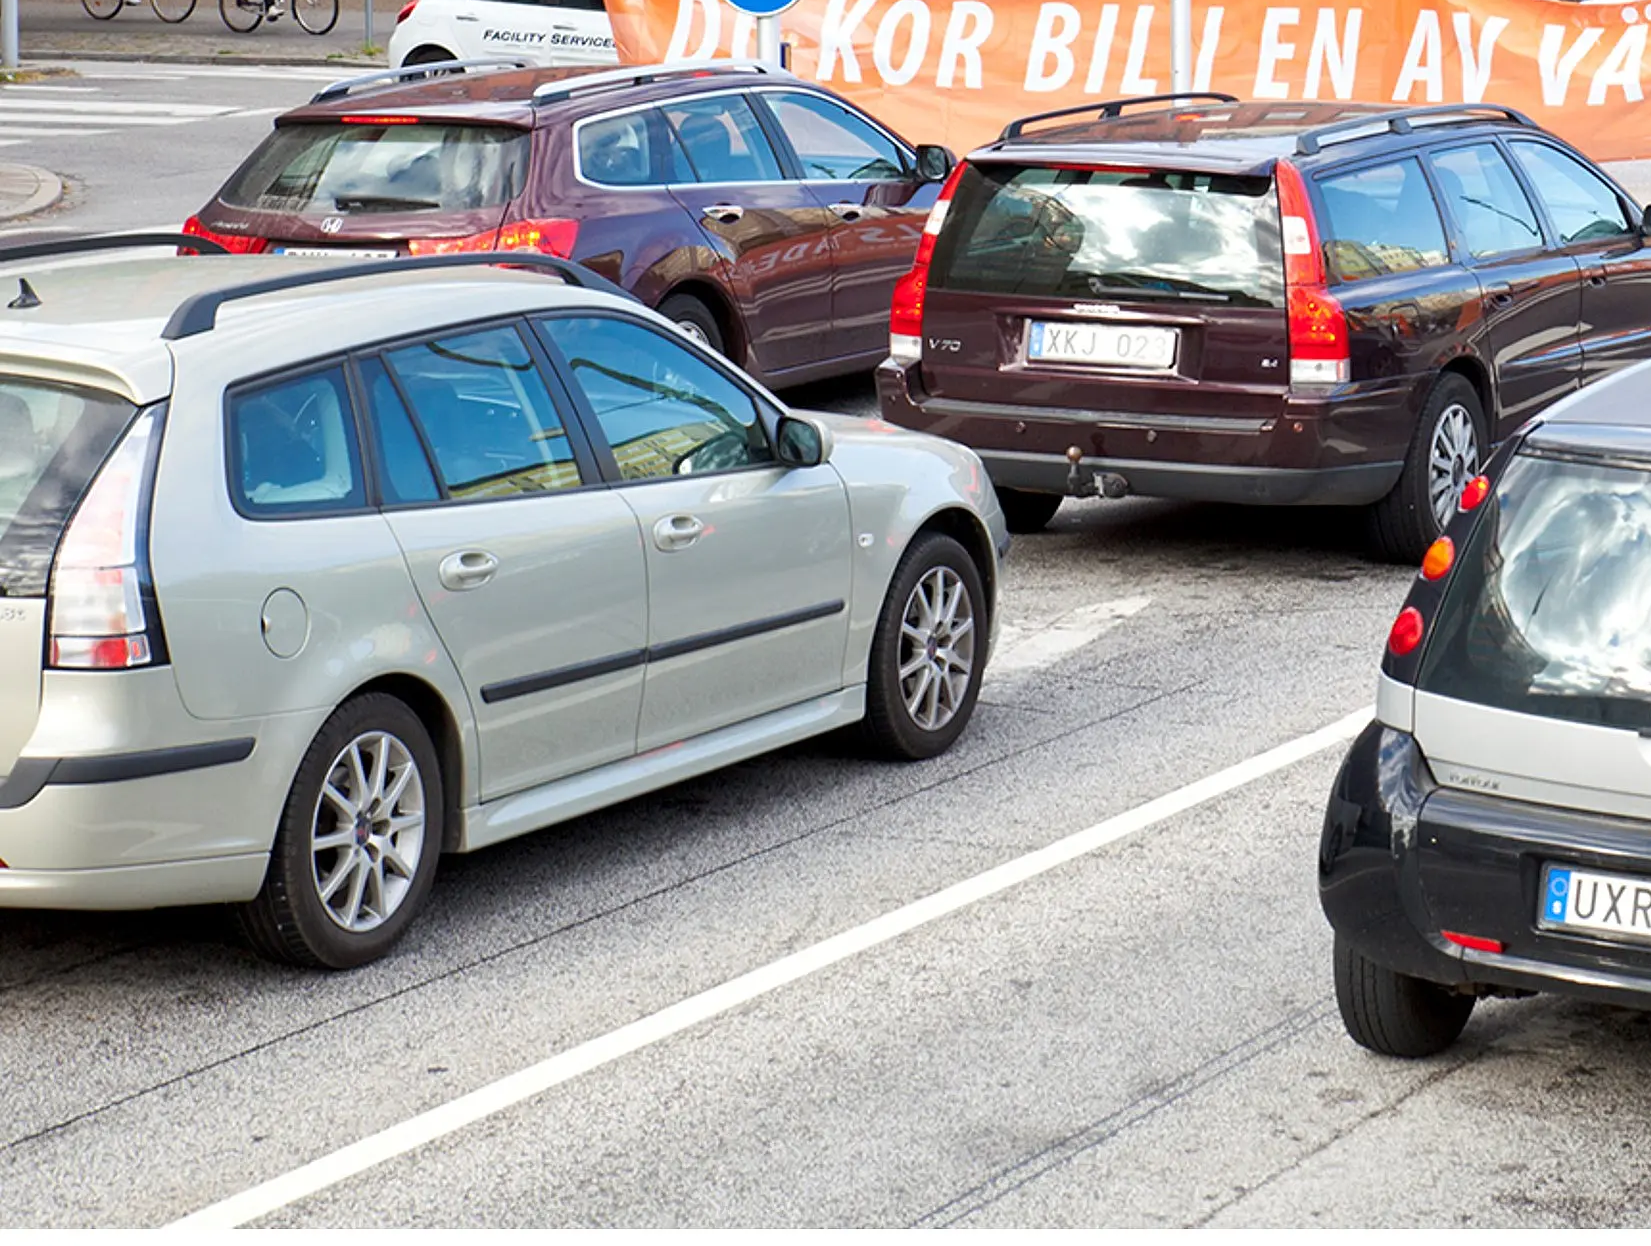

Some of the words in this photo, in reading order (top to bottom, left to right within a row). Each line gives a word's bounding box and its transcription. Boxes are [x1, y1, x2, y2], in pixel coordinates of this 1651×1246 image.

[483, 29, 546, 43] FACILITY
[1023, 2, 1158, 95] BIL
[1252, 7, 1363, 100] EN
[1392, 9, 1511, 104] AV
[927, 337, 961, 352] V70
[1047, 327, 1097, 356] XKJ
